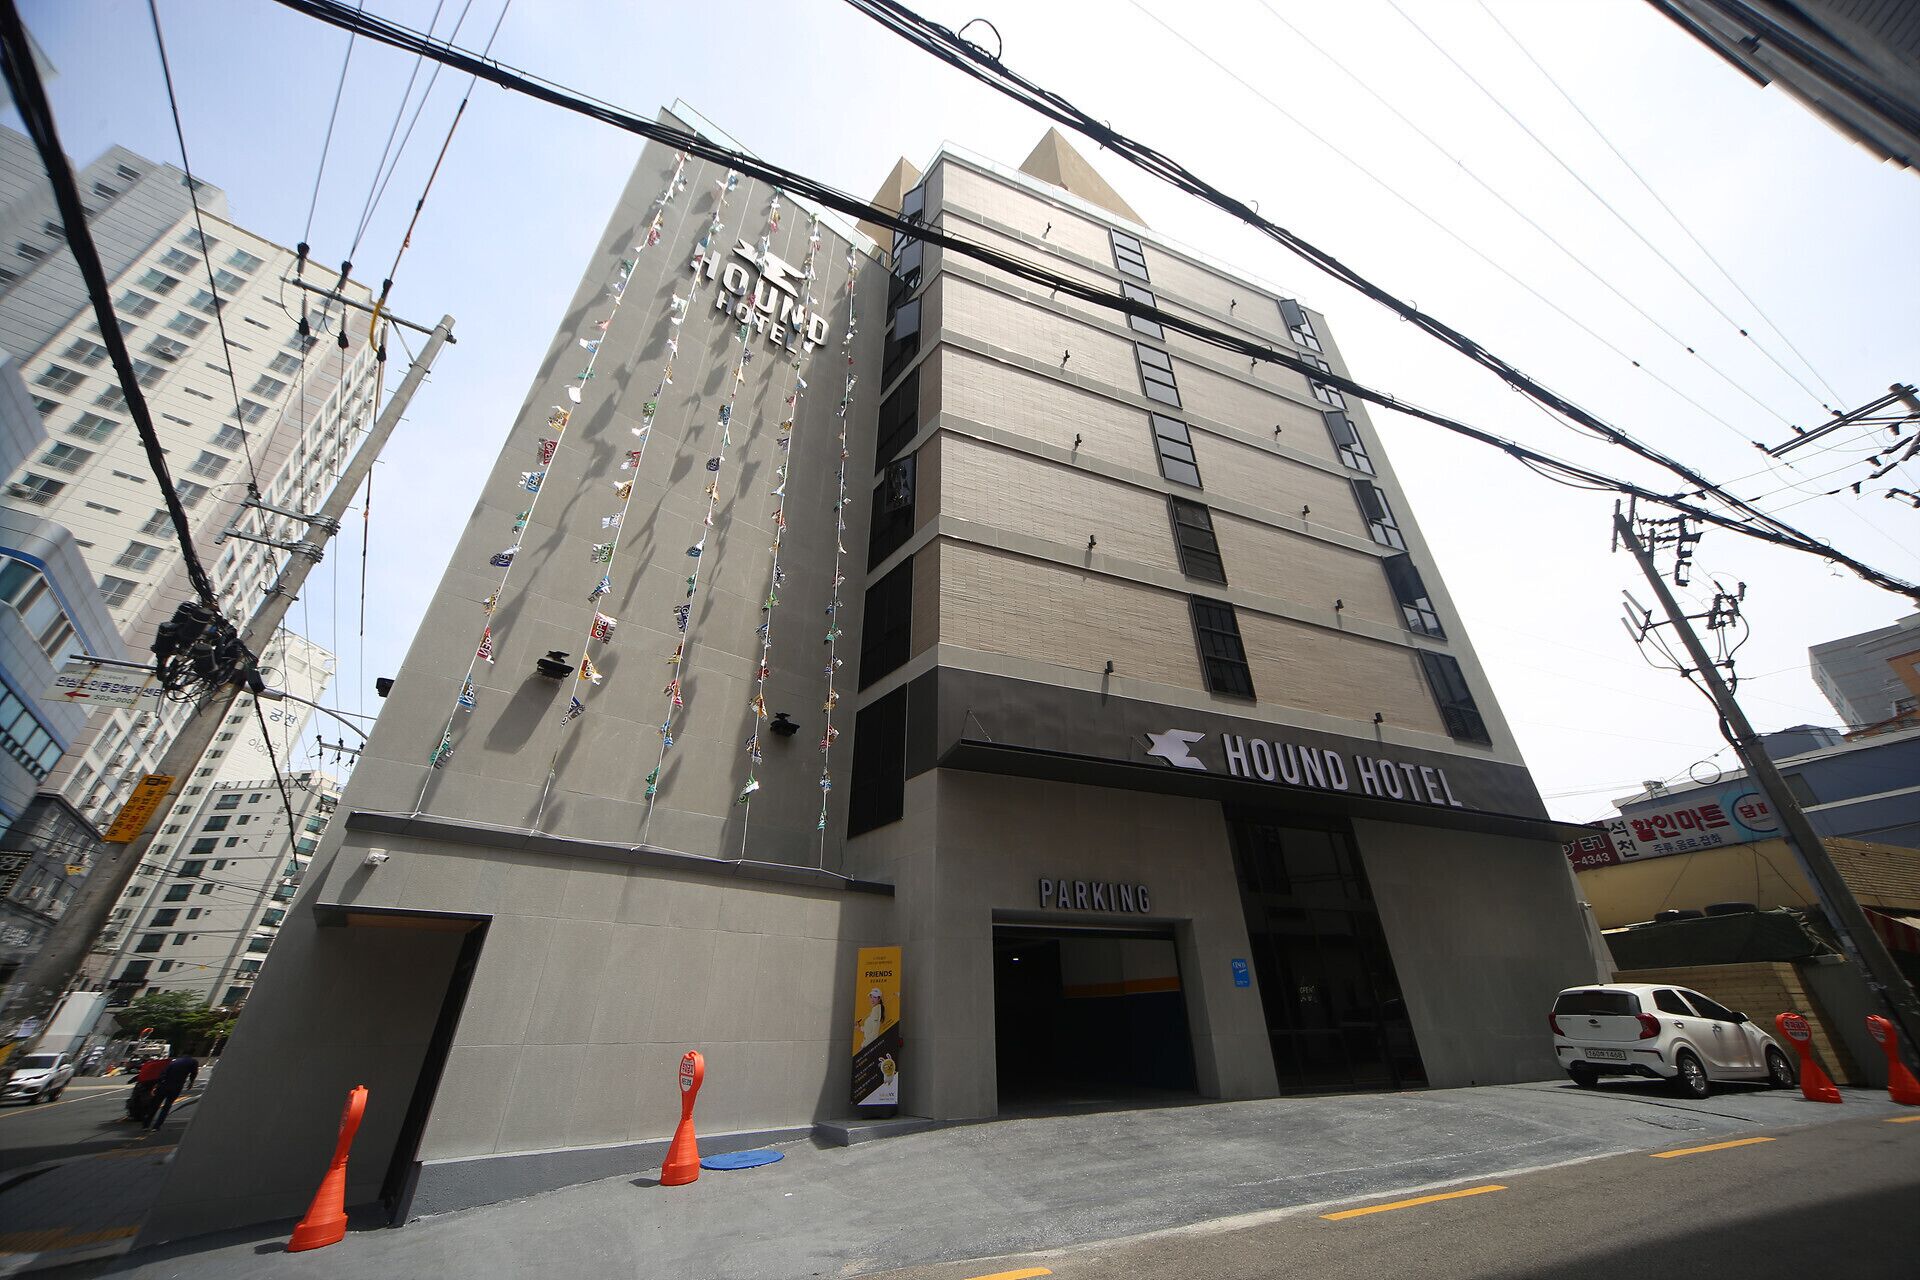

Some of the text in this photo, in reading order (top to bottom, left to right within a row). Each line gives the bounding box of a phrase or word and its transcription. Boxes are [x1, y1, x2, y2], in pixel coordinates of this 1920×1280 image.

[690, 242, 830, 346] HOUND
[716, 290, 797, 355] HOTEL
[1220, 733, 1463, 807] HOUND HOTEL
[1630, 804, 1731, 842] 할인마트
[1040, 878, 1151, 913] PARKING
